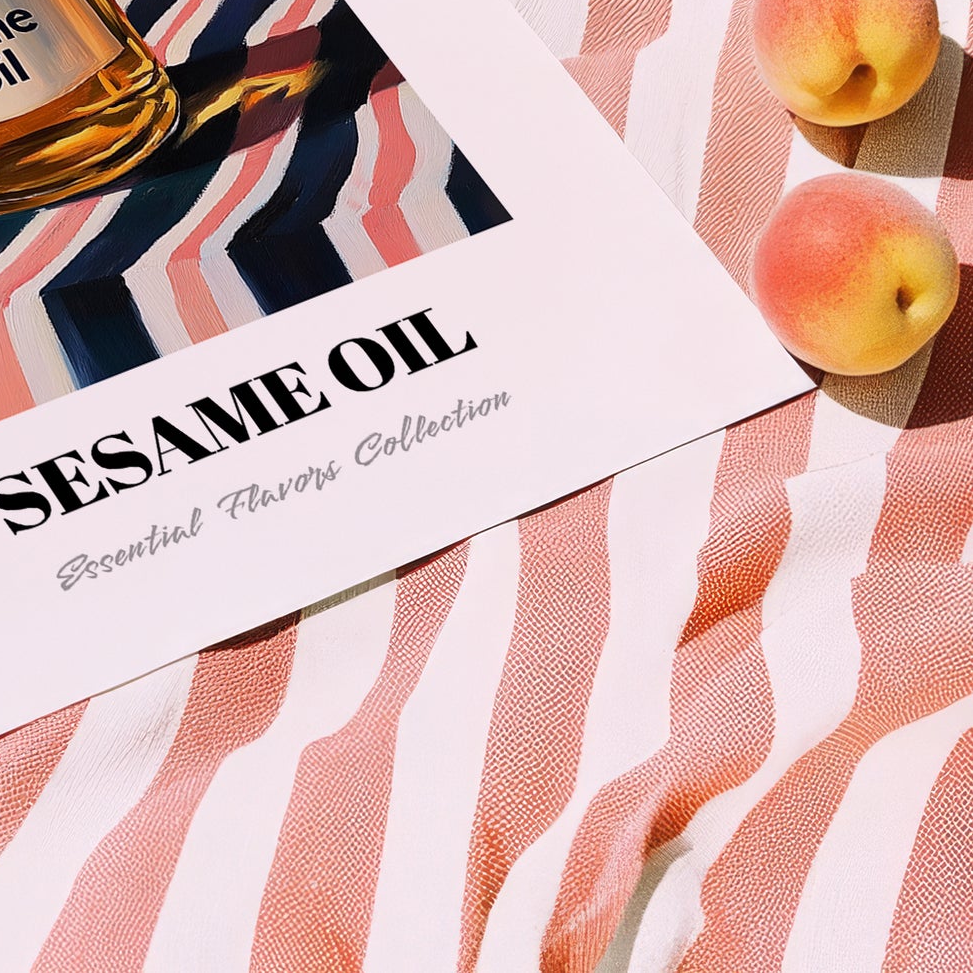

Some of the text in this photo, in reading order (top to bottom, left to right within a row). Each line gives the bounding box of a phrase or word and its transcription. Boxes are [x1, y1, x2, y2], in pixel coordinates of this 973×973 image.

[328, 307, 478, 392] OIL
[56, 390, 512, 591] Essential Flavors Collection
